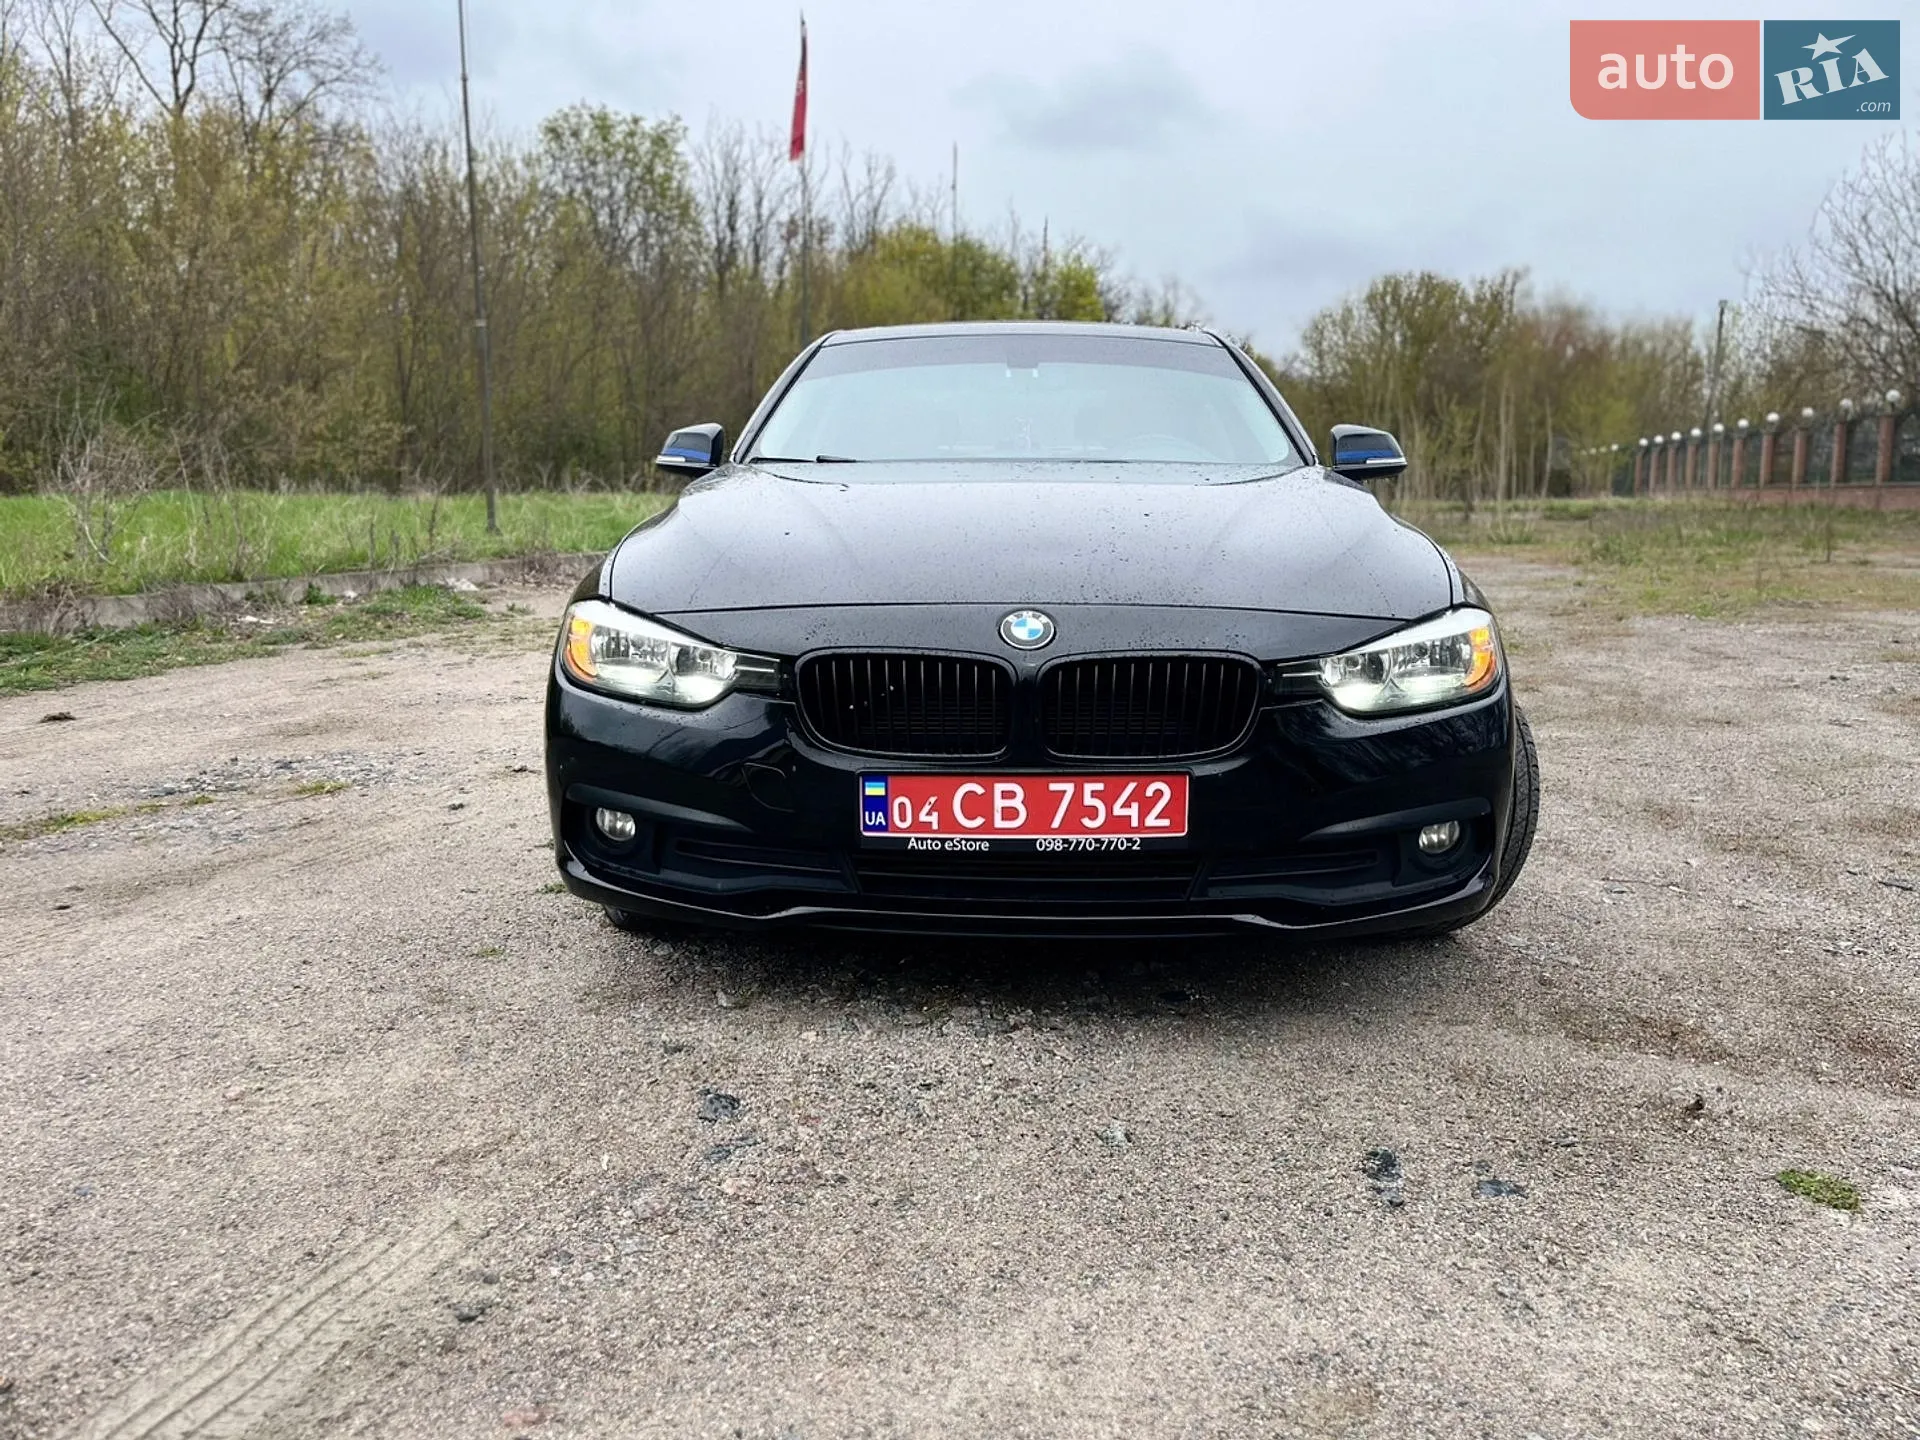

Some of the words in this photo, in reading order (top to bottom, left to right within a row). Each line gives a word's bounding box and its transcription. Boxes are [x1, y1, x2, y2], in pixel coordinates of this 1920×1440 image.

[893, 796, 939, 830] 04
[953, 782, 1028, 829] CB
[1048, 781, 1171, 829] 7542
[865, 812, 886, 825] UA
[908, 838, 941, 851] Auto
[944, 838, 990, 851] eStore
[1036, 838, 1141, 851] 098-770-770-2
